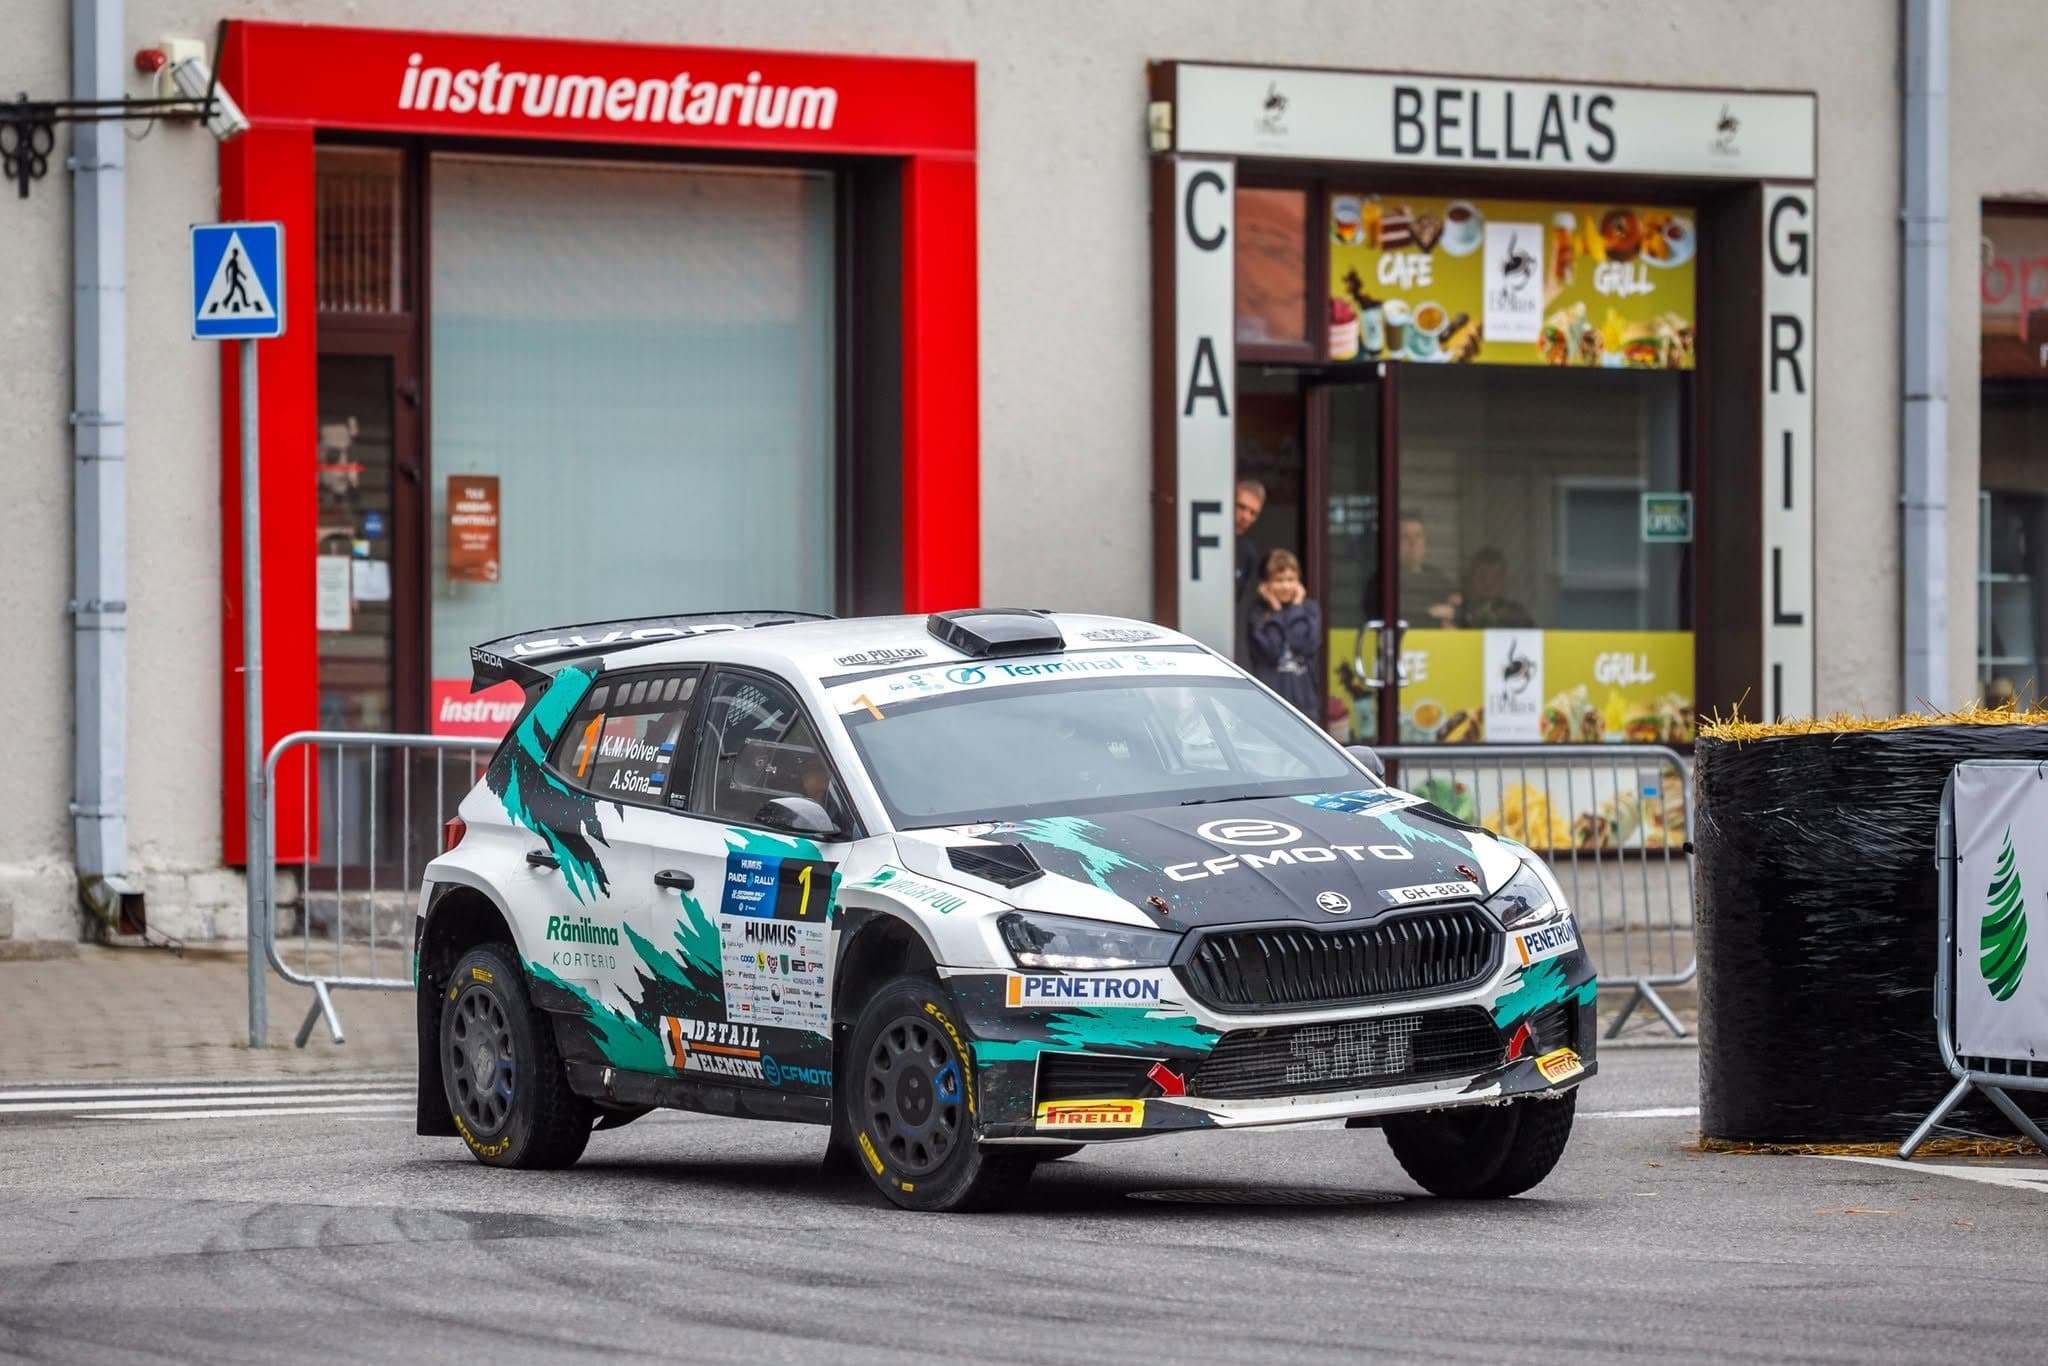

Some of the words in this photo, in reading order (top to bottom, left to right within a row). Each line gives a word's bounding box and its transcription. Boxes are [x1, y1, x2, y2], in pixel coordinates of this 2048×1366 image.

[399, 52, 838, 130] instrumentarium
[1391, 85, 1617, 164] BELLA'S
[1376, 252, 1433, 290] CAFE
[1593, 261, 1655, 297] GRILL
[838, 653, 867, 665] PRO
[868, 647, 923, 660] POLISH
[996, 659, 1124, 678] Terminal
[1594, 650, 1655, 686] GRILL
[1163, 844, 1415, 882] CFMOTO
[727, 872, 748, 883] PAIDE
[753, 875, 776, 886] RALLY
[798, 865, 814, 915] 1
[1401, 883, 1471, 900] GH-888
[546, 915, 620, 946] Ränilinna
[744, 921, 797, 947] HUMUS
[1523, 920, 1576, 955] PENETRON
[552, 951, 616, 970] KORTERID
[1024, 976, 1159, 1000] PENETRON
[693, 1020, 761, 1048] DETAIL
[699, 1054, 765, 1080] ELEMENT
[1047, 1104, 1133, 1125] PIRELLI
